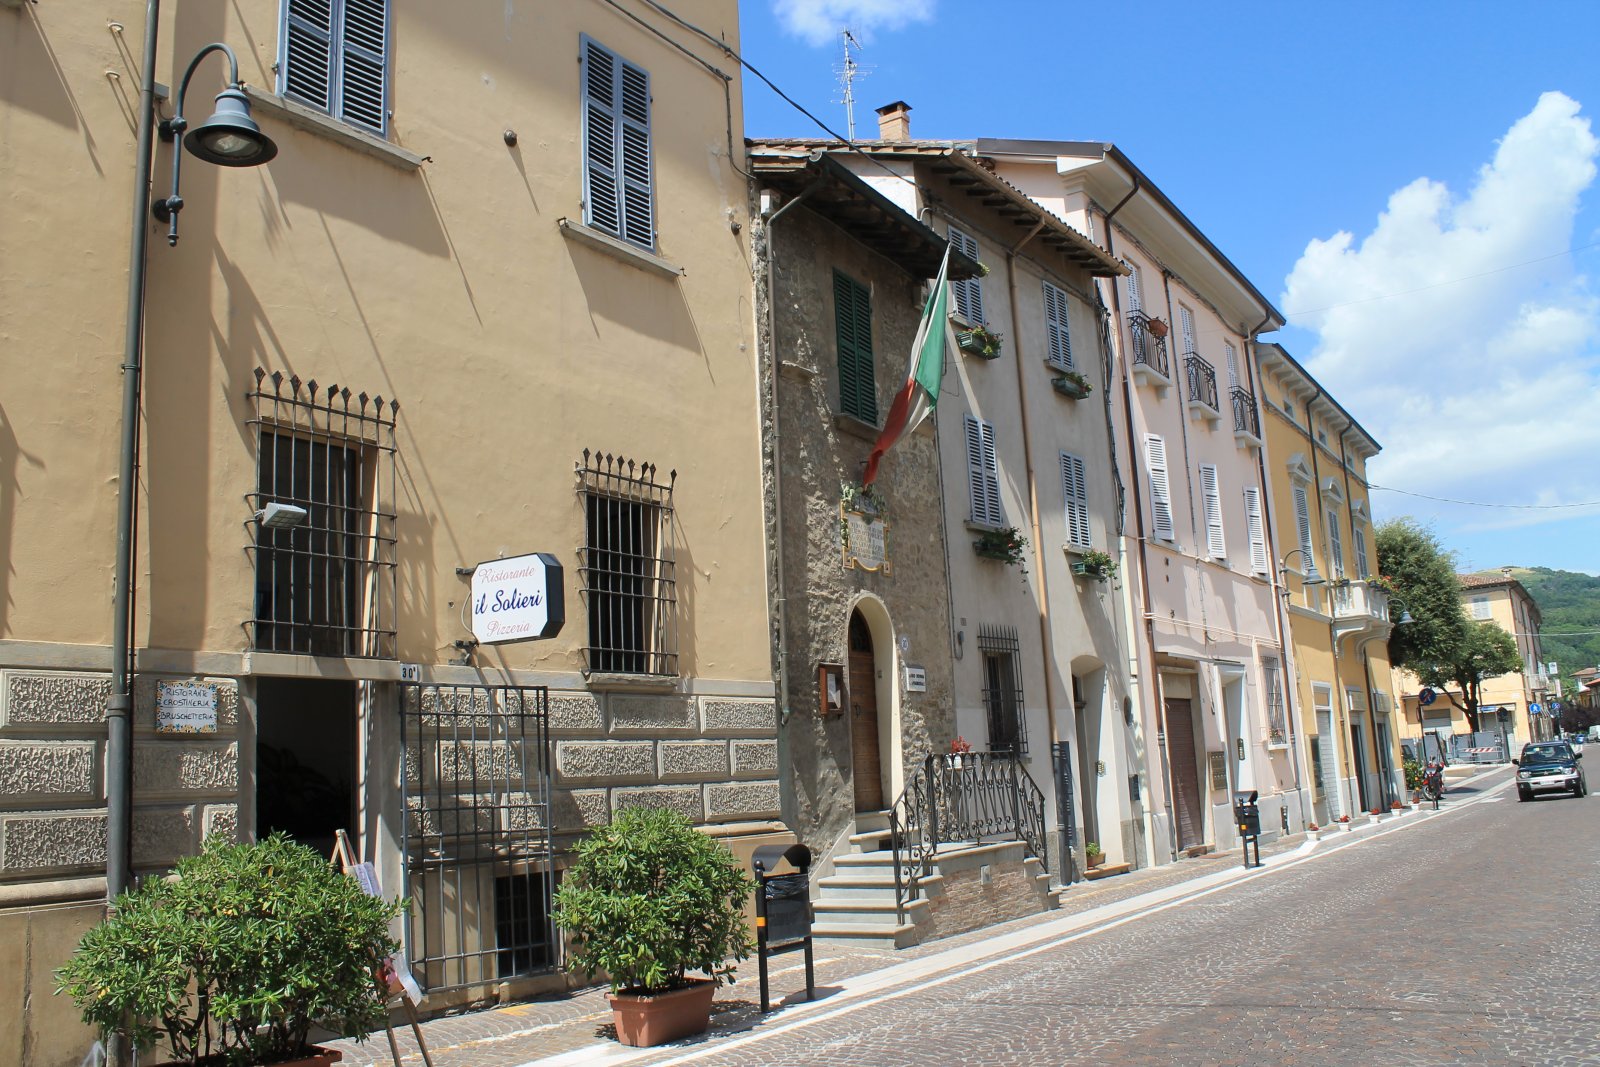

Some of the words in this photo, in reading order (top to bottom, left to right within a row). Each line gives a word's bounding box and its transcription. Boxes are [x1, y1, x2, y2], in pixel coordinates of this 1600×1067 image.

[478, 566, 535, 584] Ristorante
[475, 592, 488, 615] il
[491, 587, 543, 613] Solieri
[487, 620, 530, 637] Pizzeria
